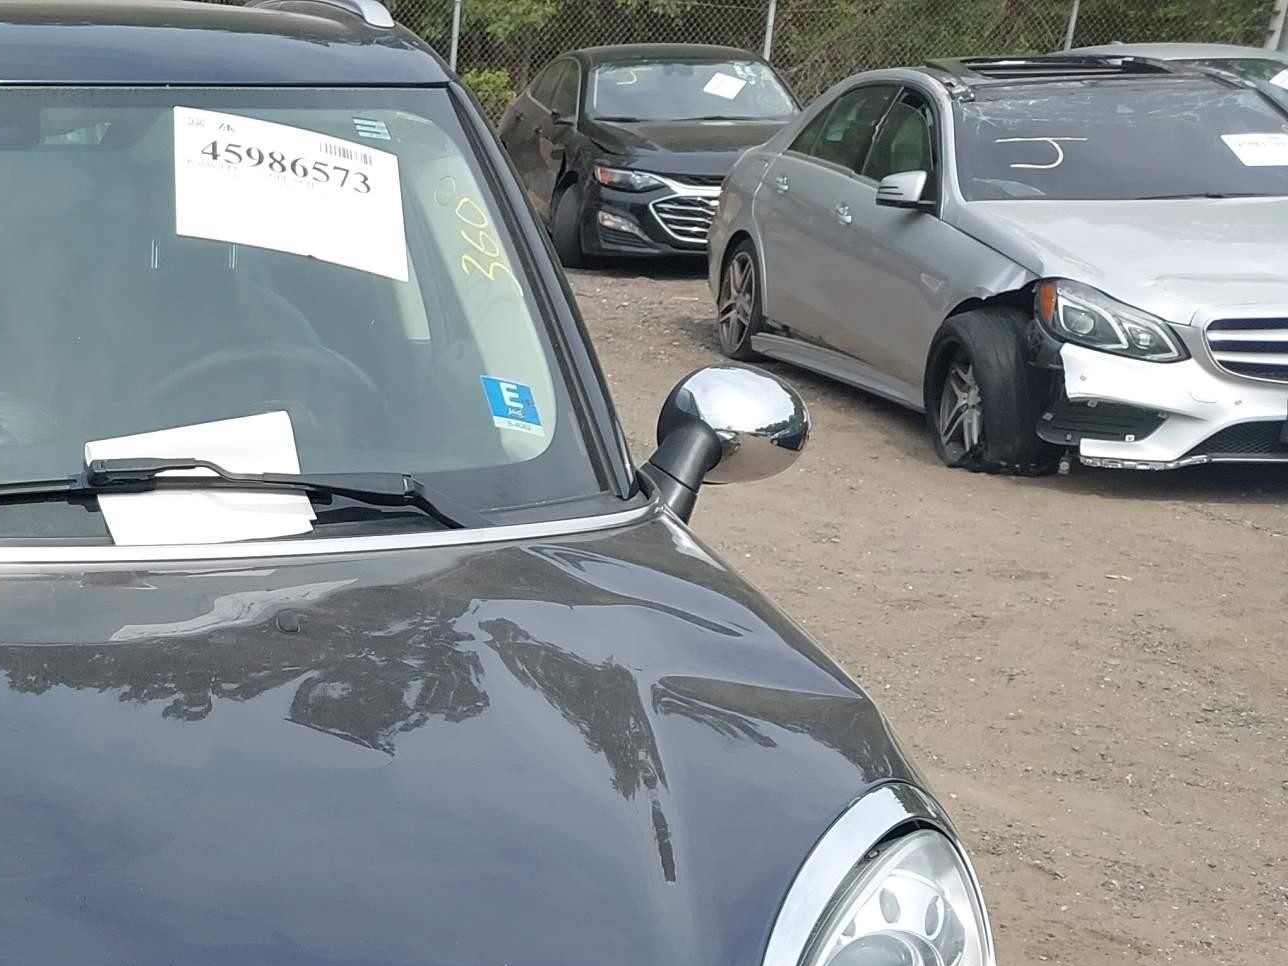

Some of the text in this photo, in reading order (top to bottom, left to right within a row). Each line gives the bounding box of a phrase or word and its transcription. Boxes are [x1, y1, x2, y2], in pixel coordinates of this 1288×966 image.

[200, 140, 372, 194] 45986573
[455, 197, 524, 297] 360
[499, 381, 524, 409] E
